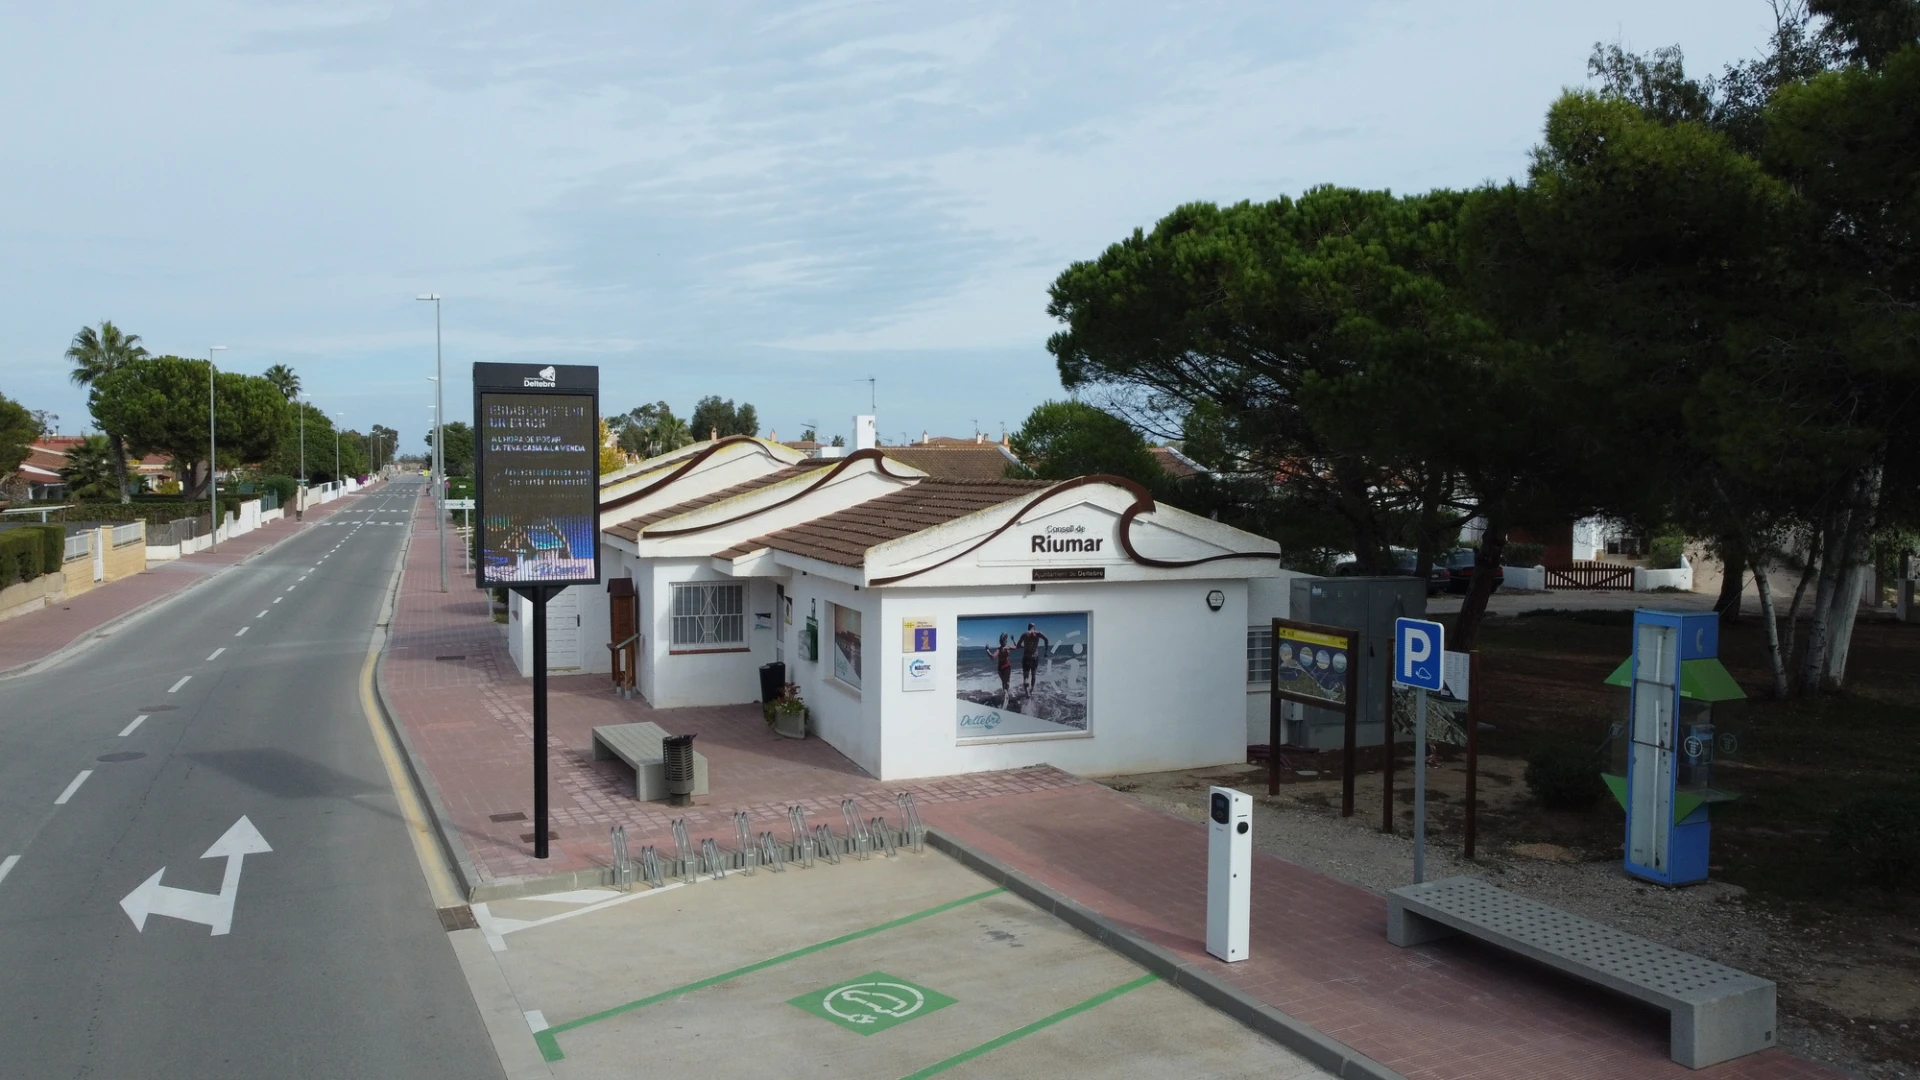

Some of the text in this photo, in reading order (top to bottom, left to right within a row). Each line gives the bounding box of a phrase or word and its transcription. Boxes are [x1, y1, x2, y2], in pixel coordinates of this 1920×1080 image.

[523, 379, 556, 388] Deltebre
[1045, 525, 1086, 533] Consell de
[1031, 535, 1103, 553] Riumar
[1404, 627, 1431, 678] P
[960, 713, 1002, 727] Deltebre
